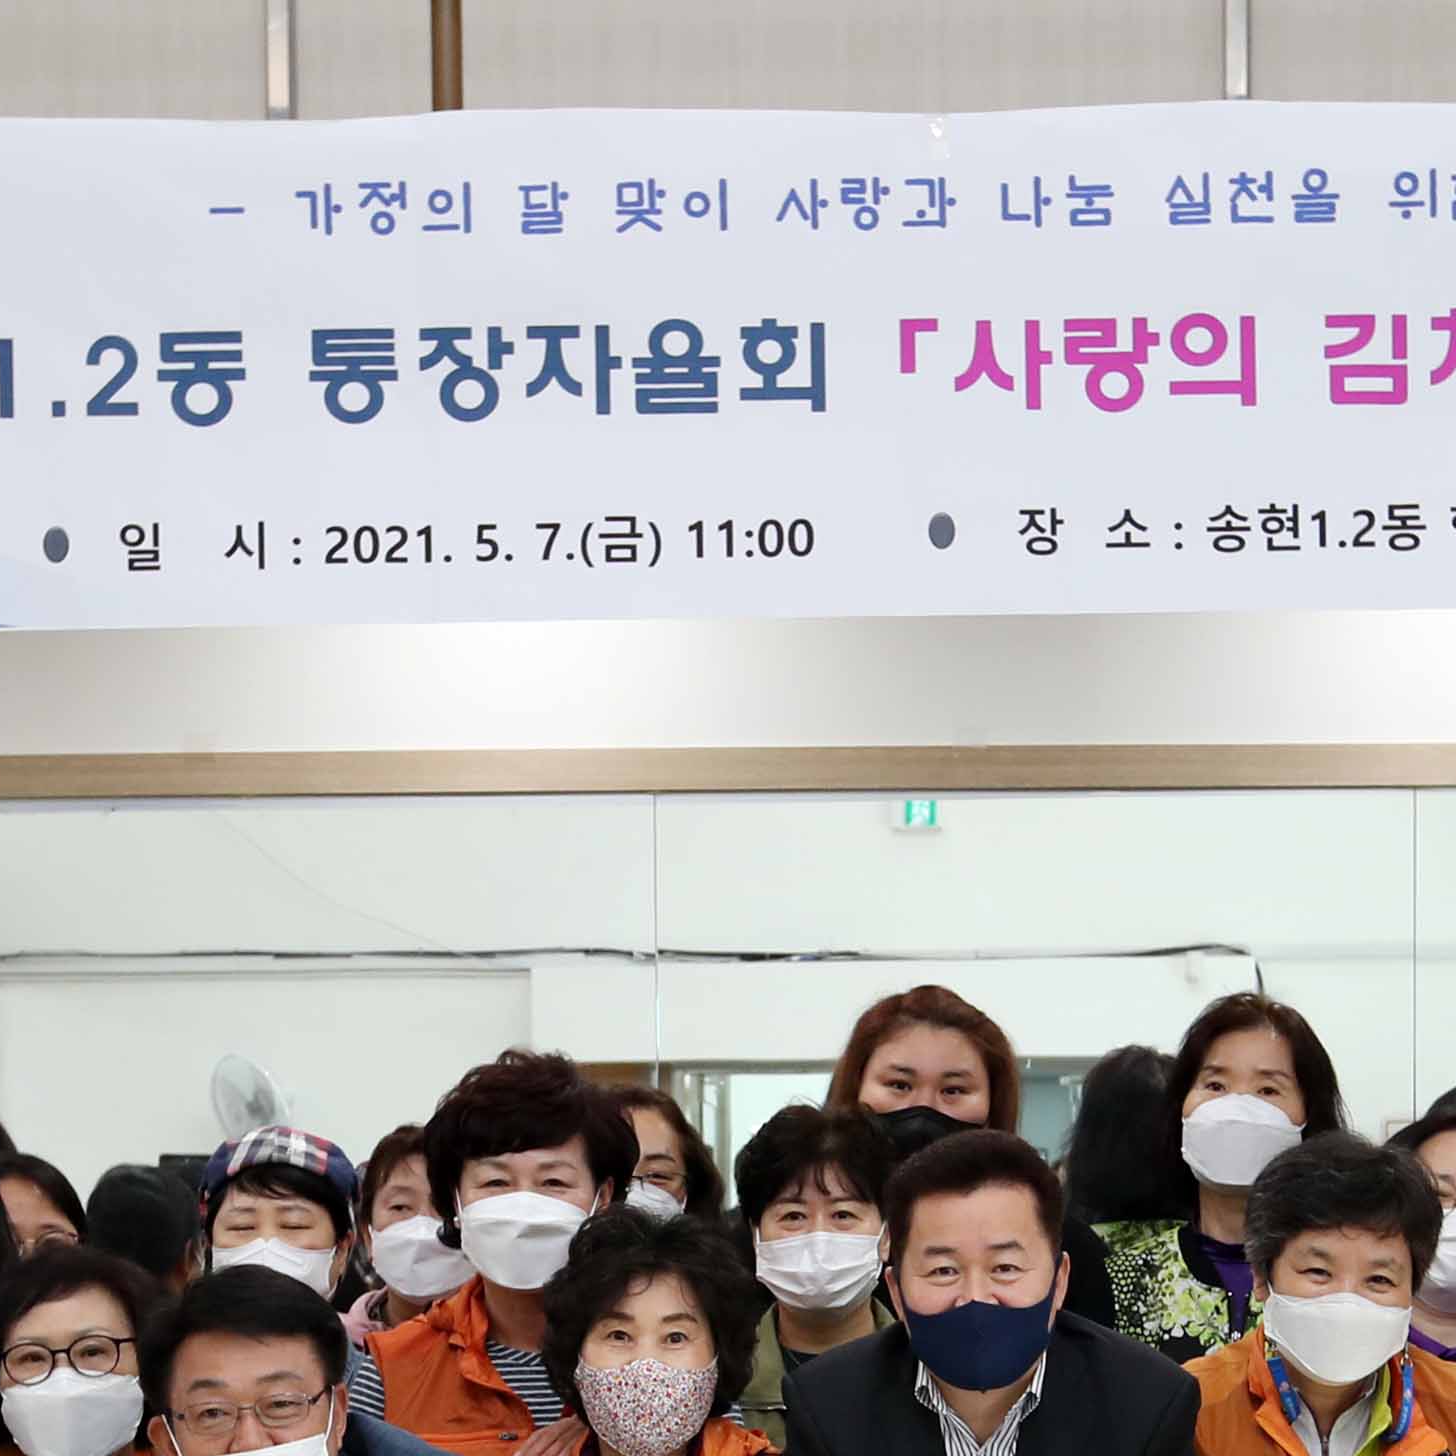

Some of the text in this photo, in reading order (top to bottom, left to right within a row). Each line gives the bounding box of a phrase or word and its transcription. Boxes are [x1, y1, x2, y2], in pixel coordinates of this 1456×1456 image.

[295, 180, 472, 236] 가정의
[518, 181, 569, 235] 달
[615, 178, 728, 234] 맞이
[775, 176, 957, 232] 사랑과
[1000, 174, 1115, 228] 나눔
[1165, 168, 1340, 226] 실천을
[308, 318, 826, 425] 통장자율회
[119, 522, 161, 572] 일
[324, 525, 452, 564] 2021.
[476, 523, 513, 562] 5.
[535, 515, 662, 568] 7.(금)
[688, 518, 814, 559] 11:00
[1018, 507, 1065, 556] 장
[1206, 503, 1427, 553] 송현1.2동
